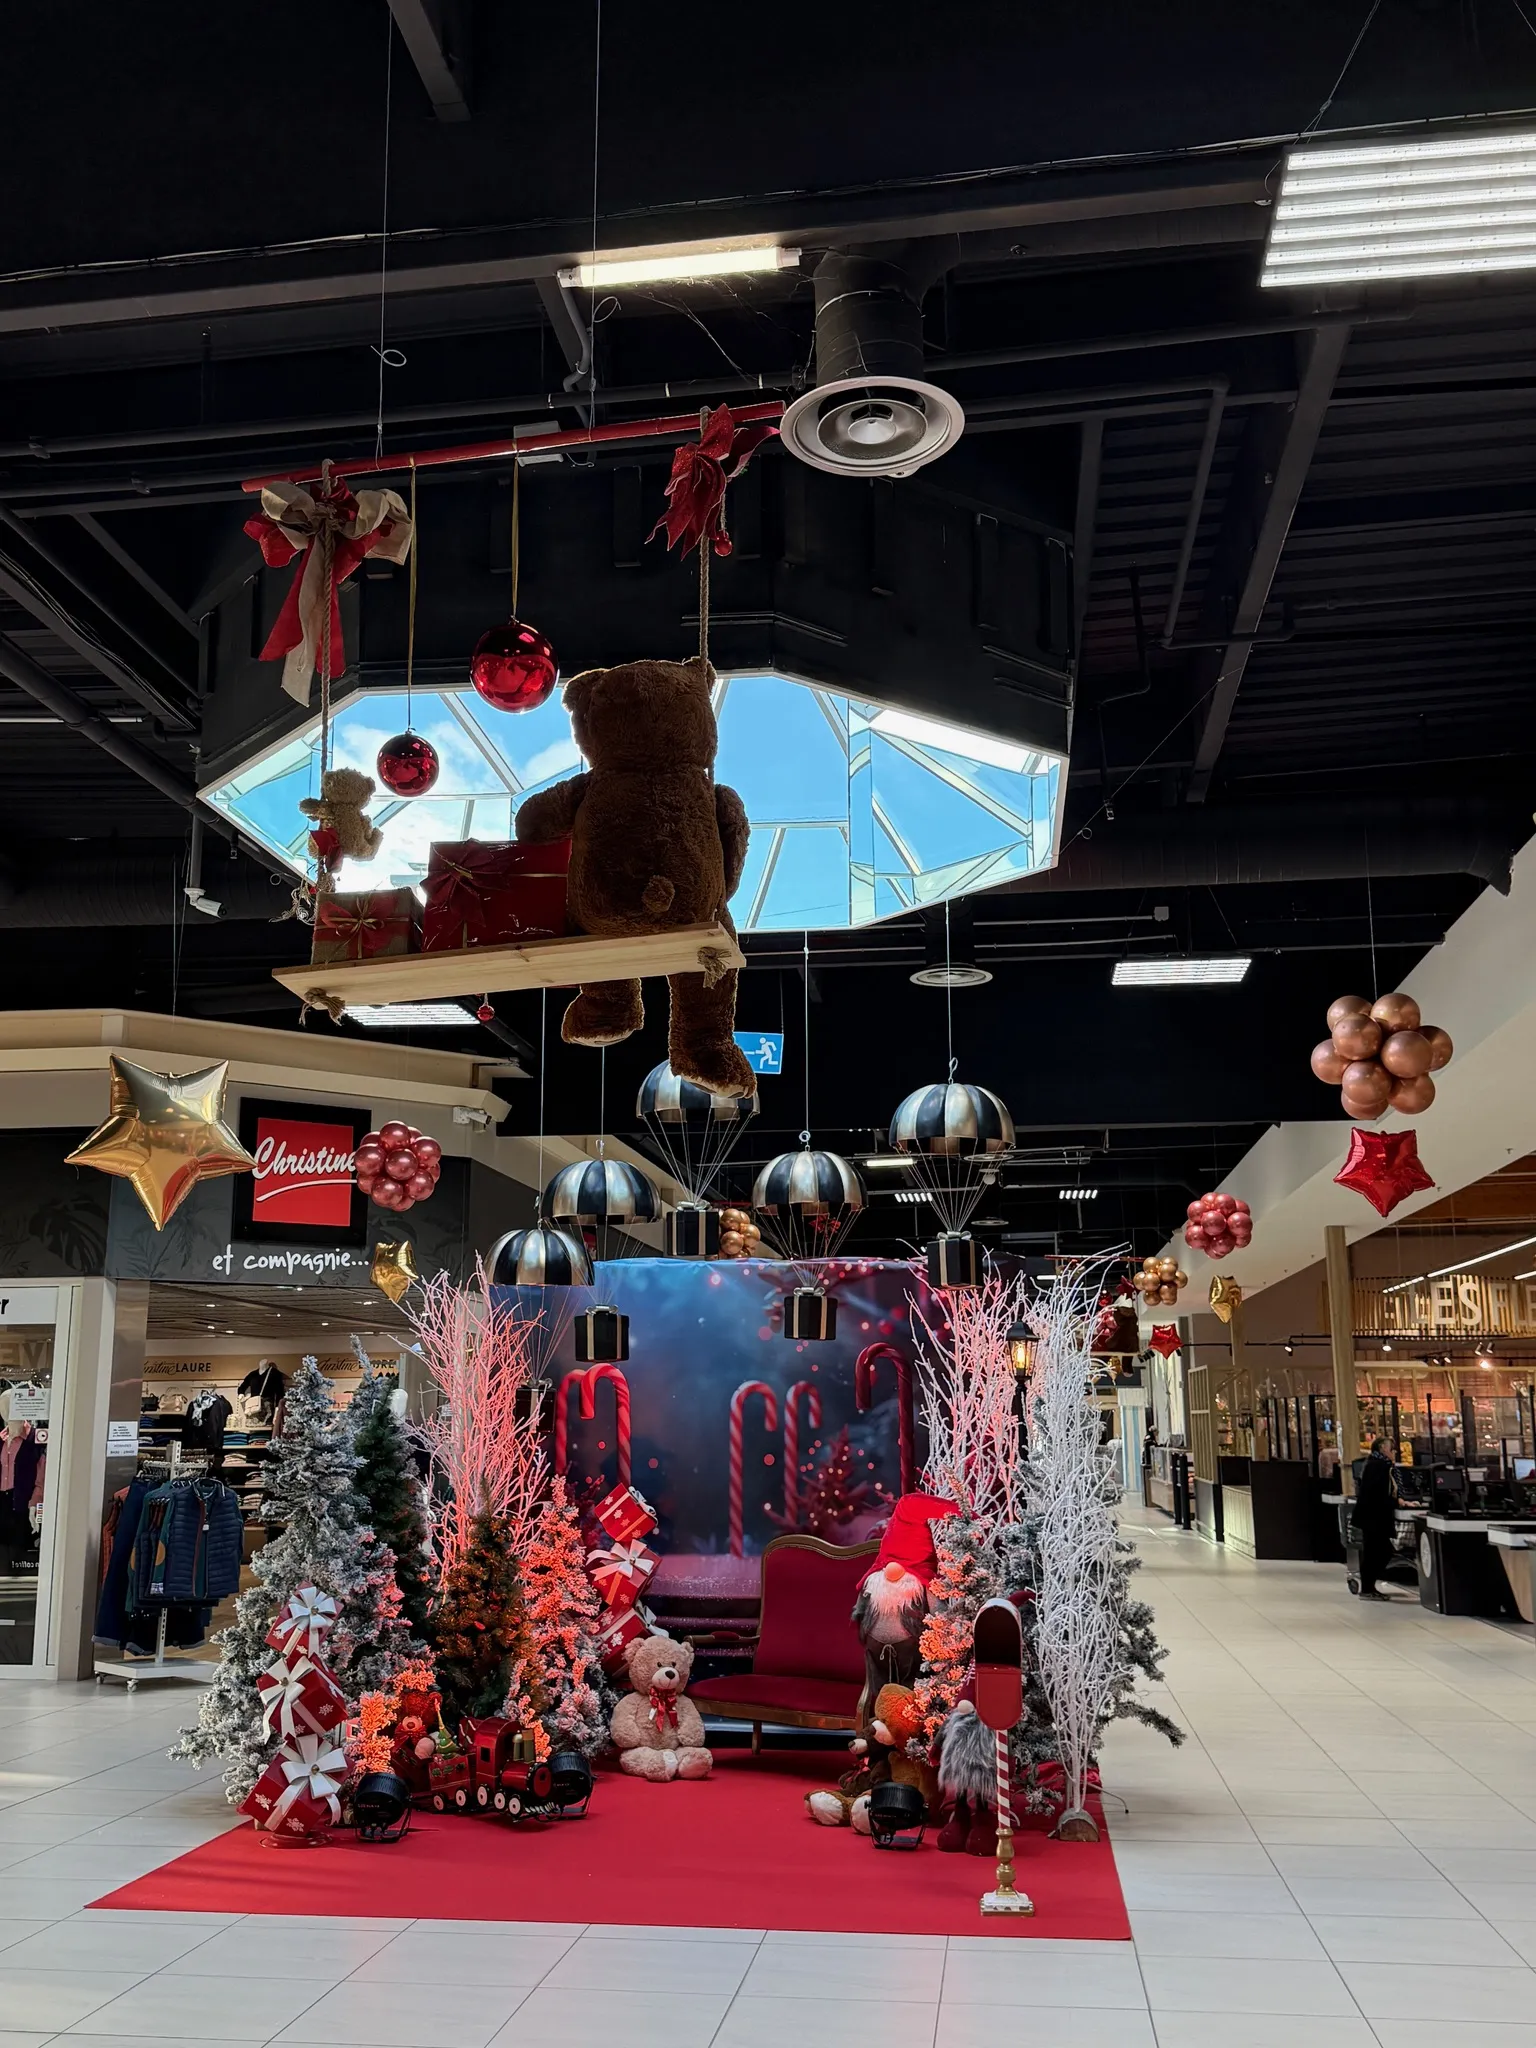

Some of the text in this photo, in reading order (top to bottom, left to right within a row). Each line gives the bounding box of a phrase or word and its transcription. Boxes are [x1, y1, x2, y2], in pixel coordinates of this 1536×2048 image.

[252, 1136, 356, 1180] Christine
[212, 1244, 369, 1275] et compagnie...
[176, 1363, 211, 1373] LAURE
